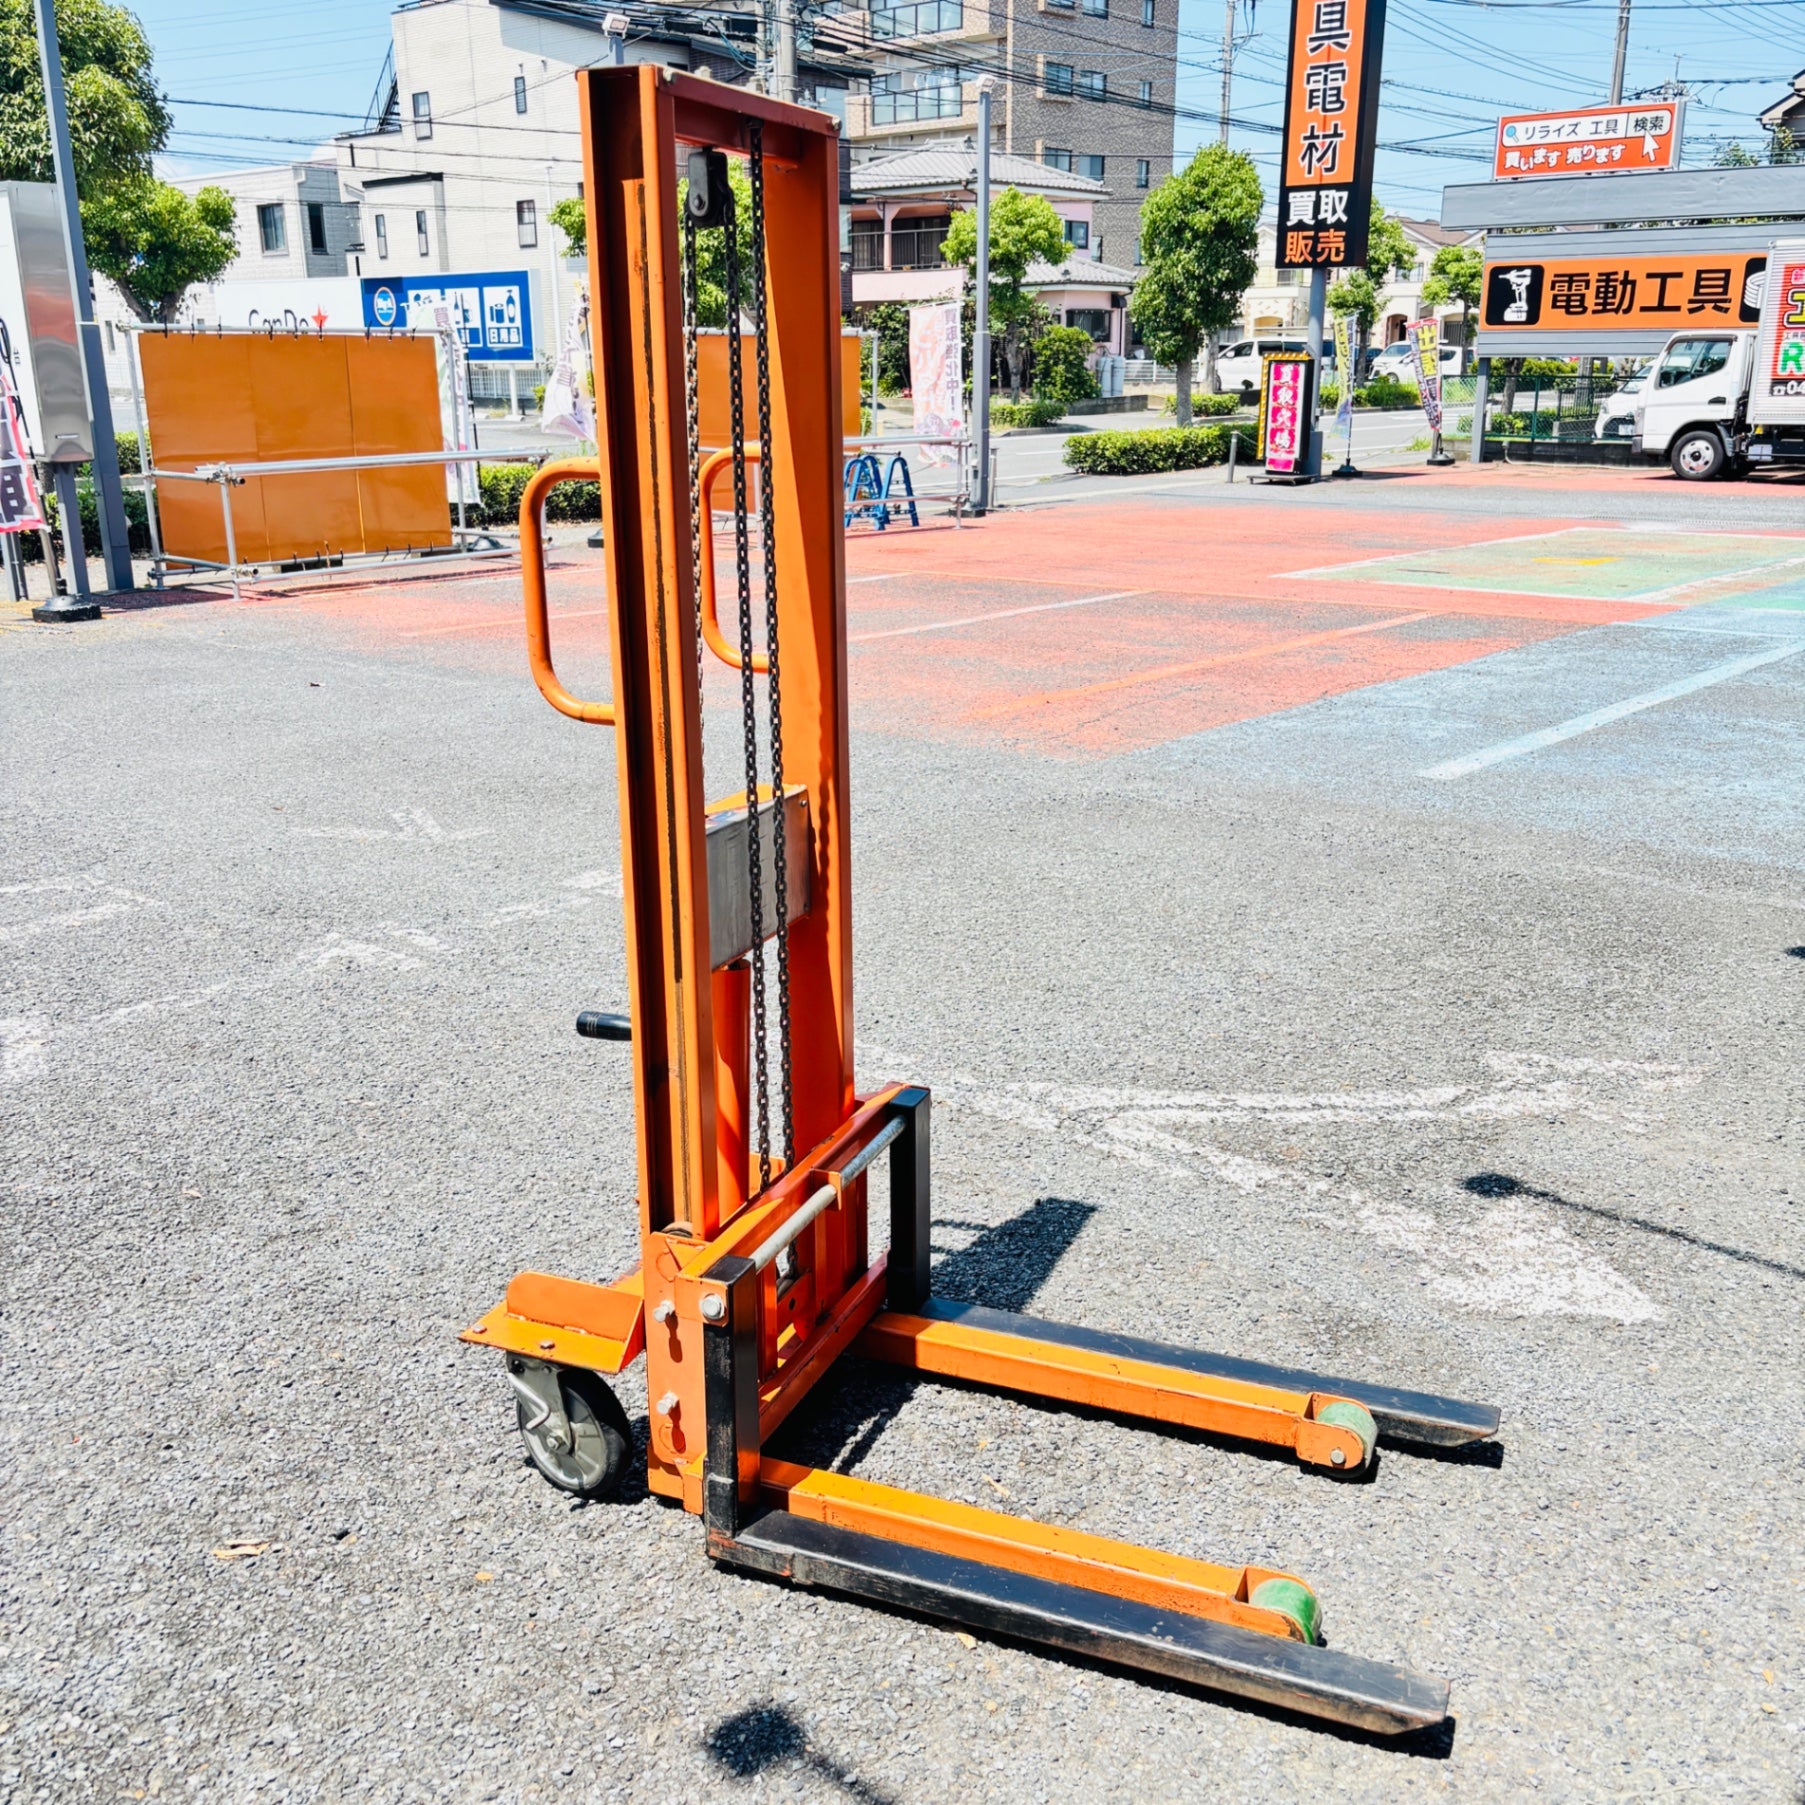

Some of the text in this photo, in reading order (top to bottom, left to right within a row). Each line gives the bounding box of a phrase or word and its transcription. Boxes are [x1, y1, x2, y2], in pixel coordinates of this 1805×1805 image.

[1524, 118, 1619, 141] リライズ 工具
[1633, 115, 1665, 133] 検索
[1504, 143, 1627, 172] 買います 売ります
[1286, 191, 1349, 226] 買取
[1284, 228, 1347, 265] 販売
[1549, 268, 1733, 316] 電動工具
